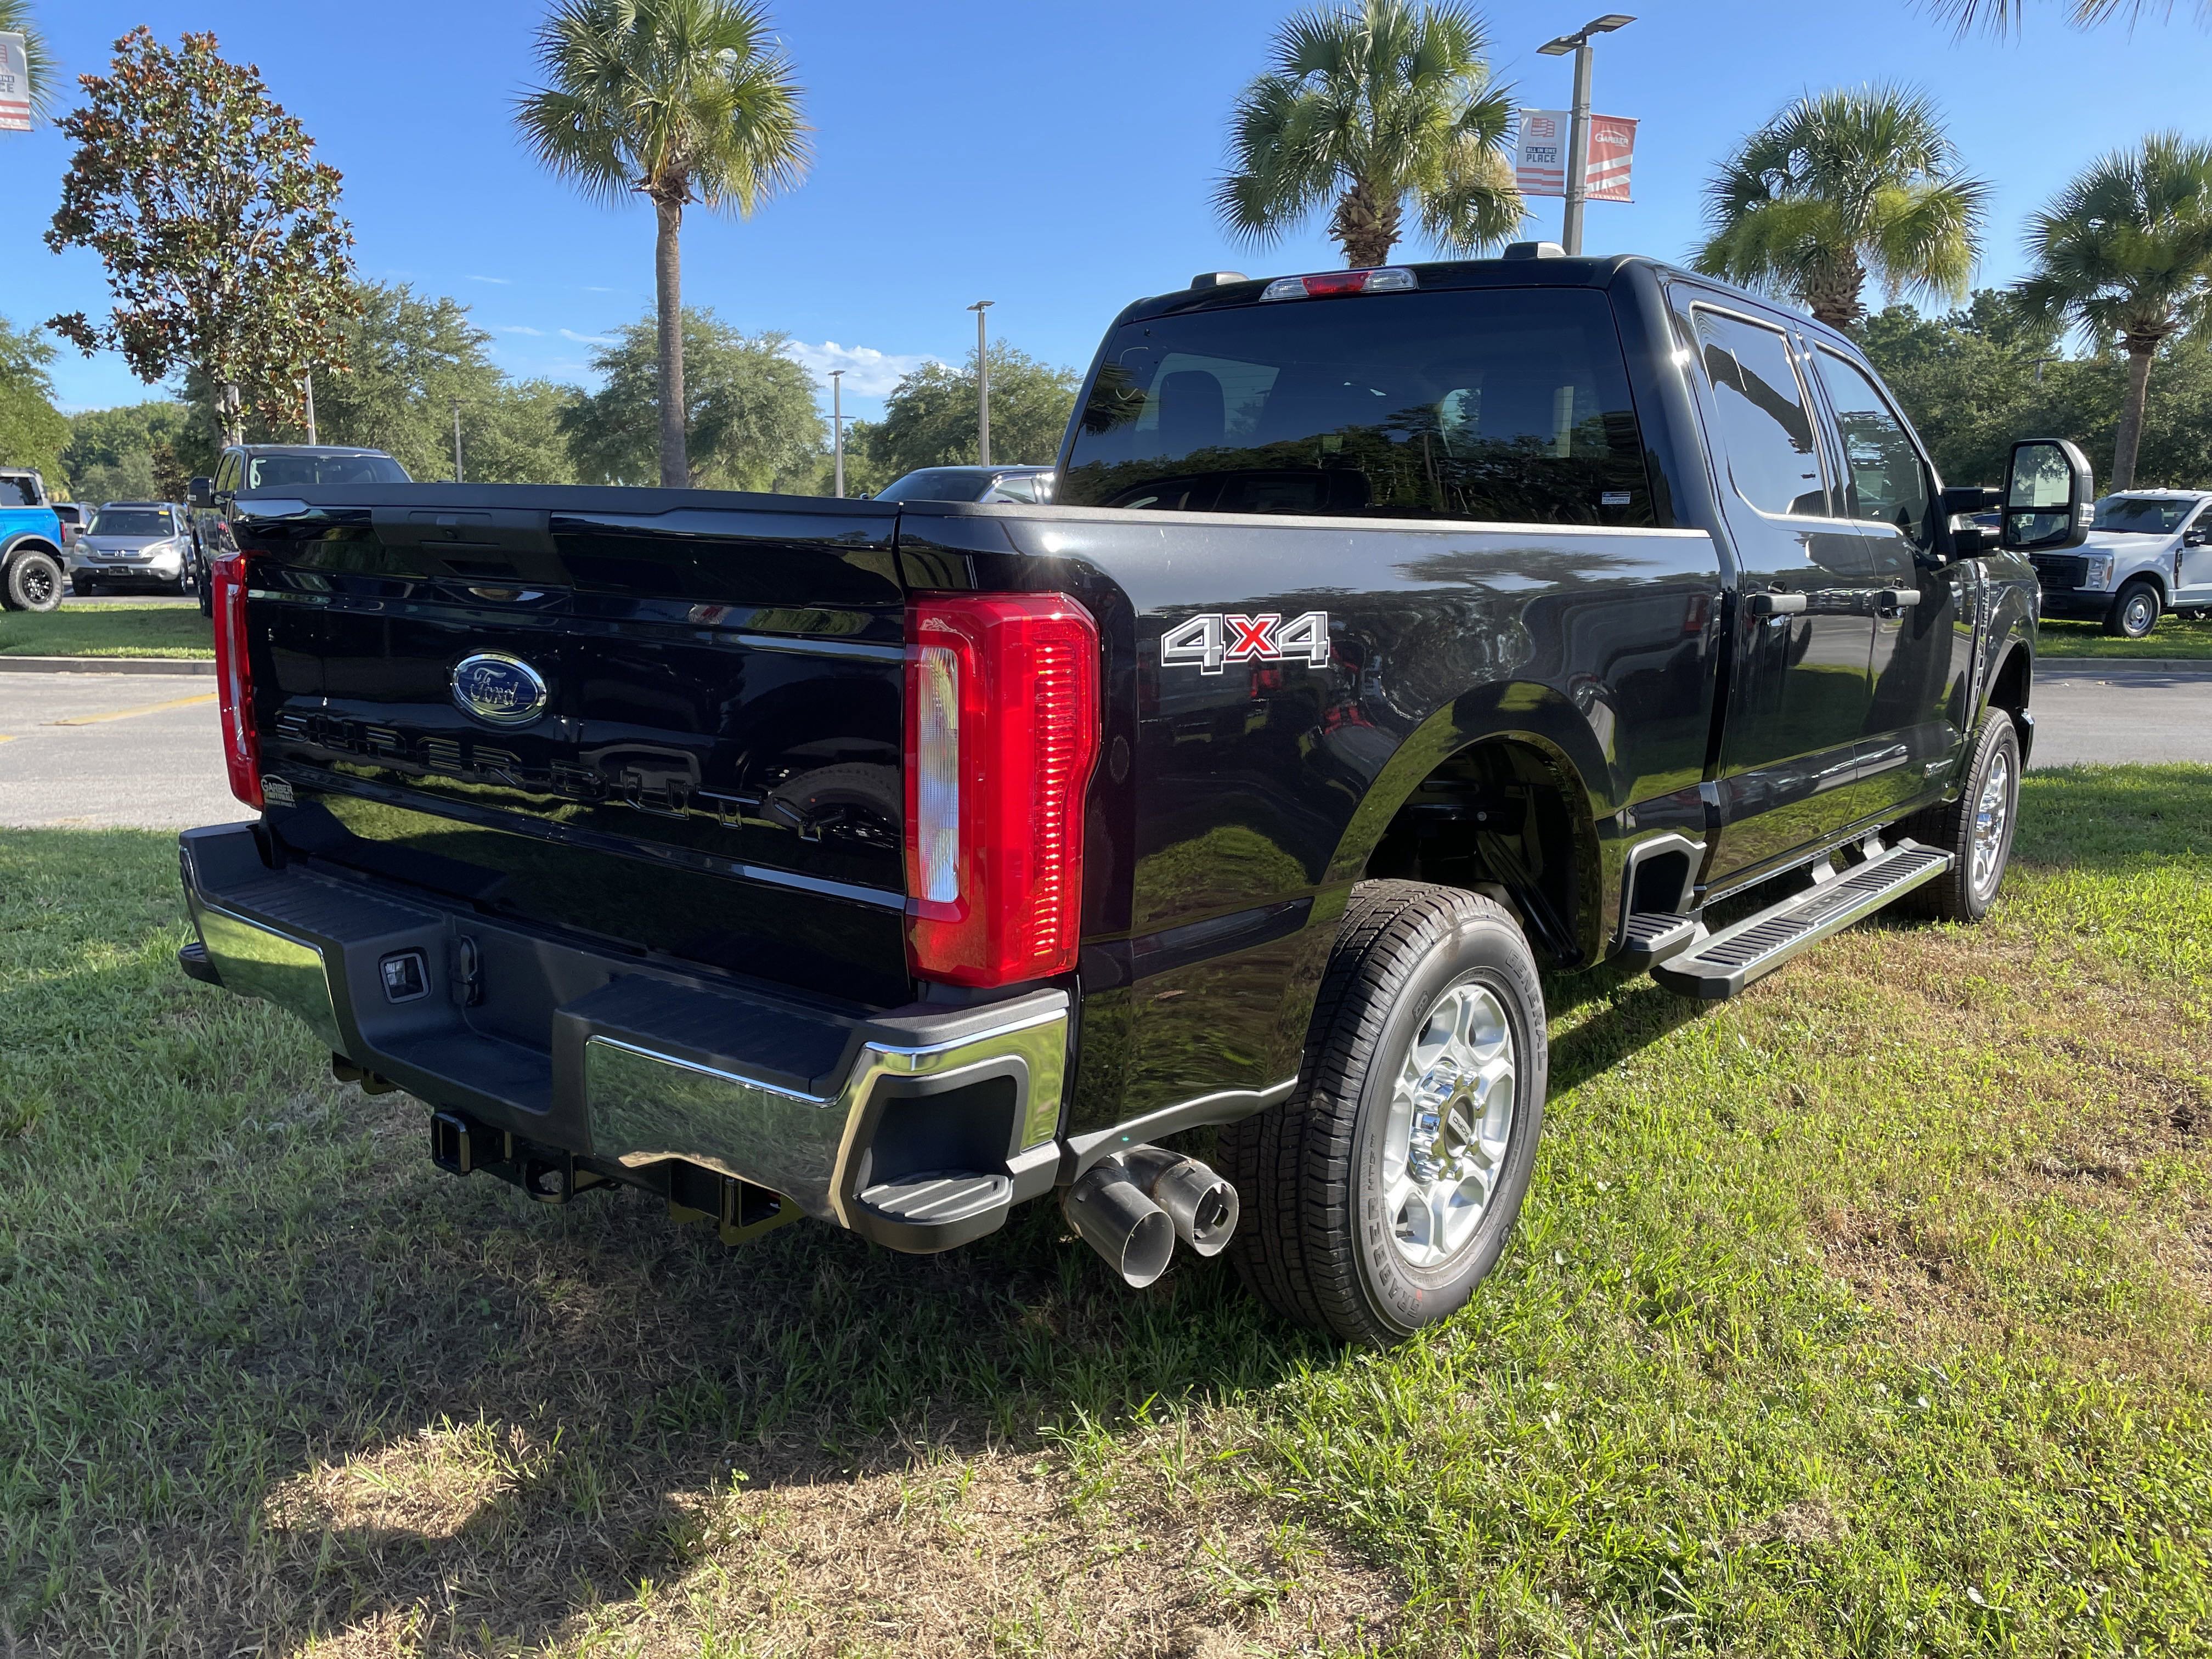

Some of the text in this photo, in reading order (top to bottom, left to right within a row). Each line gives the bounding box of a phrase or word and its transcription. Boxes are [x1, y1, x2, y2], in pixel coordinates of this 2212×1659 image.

[1526, 154, 1556, 162] PLACE
[274, 710, 525, 786] SUPER
[261, 778, 294, 795] GARBER
[1505, 949, 1547, 1071] GENERAL
[1453, 1116, 1469, 1138] FORD
[1368, 1197, 1423, 1318] GRABBER
